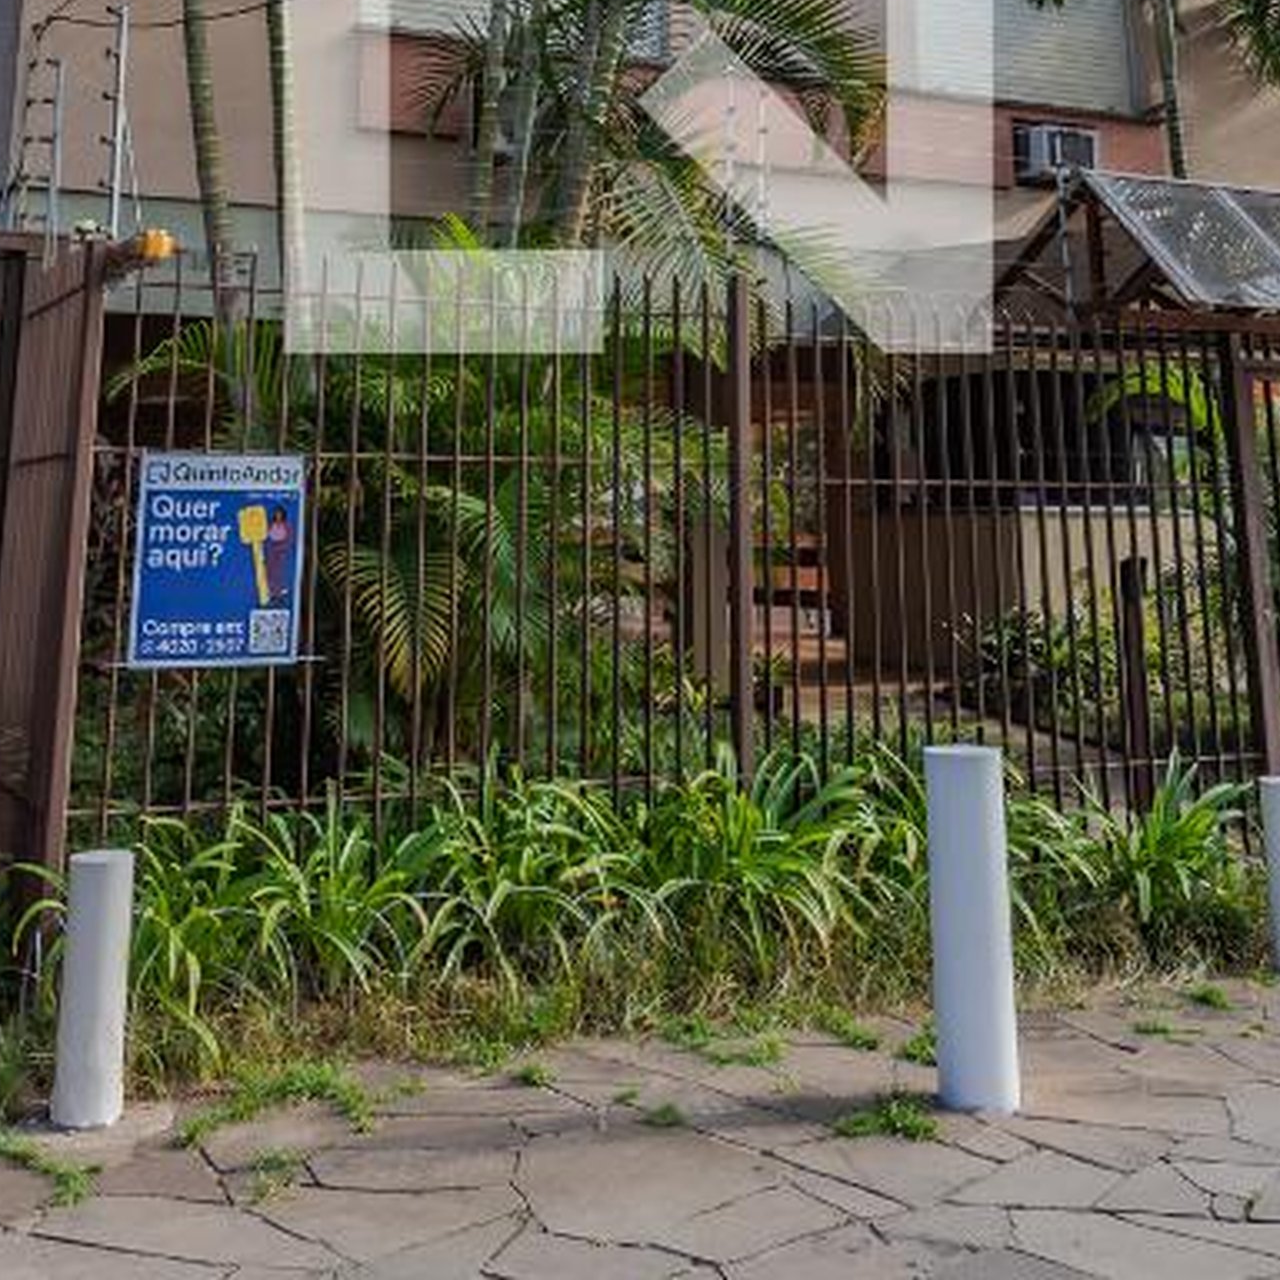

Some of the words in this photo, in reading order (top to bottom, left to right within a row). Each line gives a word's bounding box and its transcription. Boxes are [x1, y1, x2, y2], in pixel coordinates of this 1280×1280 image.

[173, 462, 300, 483] QuintoAndar
[152, 495, 221, 520] Quer
[149, 524, 231, 542] morar
[148, 543, 223, 571] aqui?
[142, 619, 211, 638] Compre
